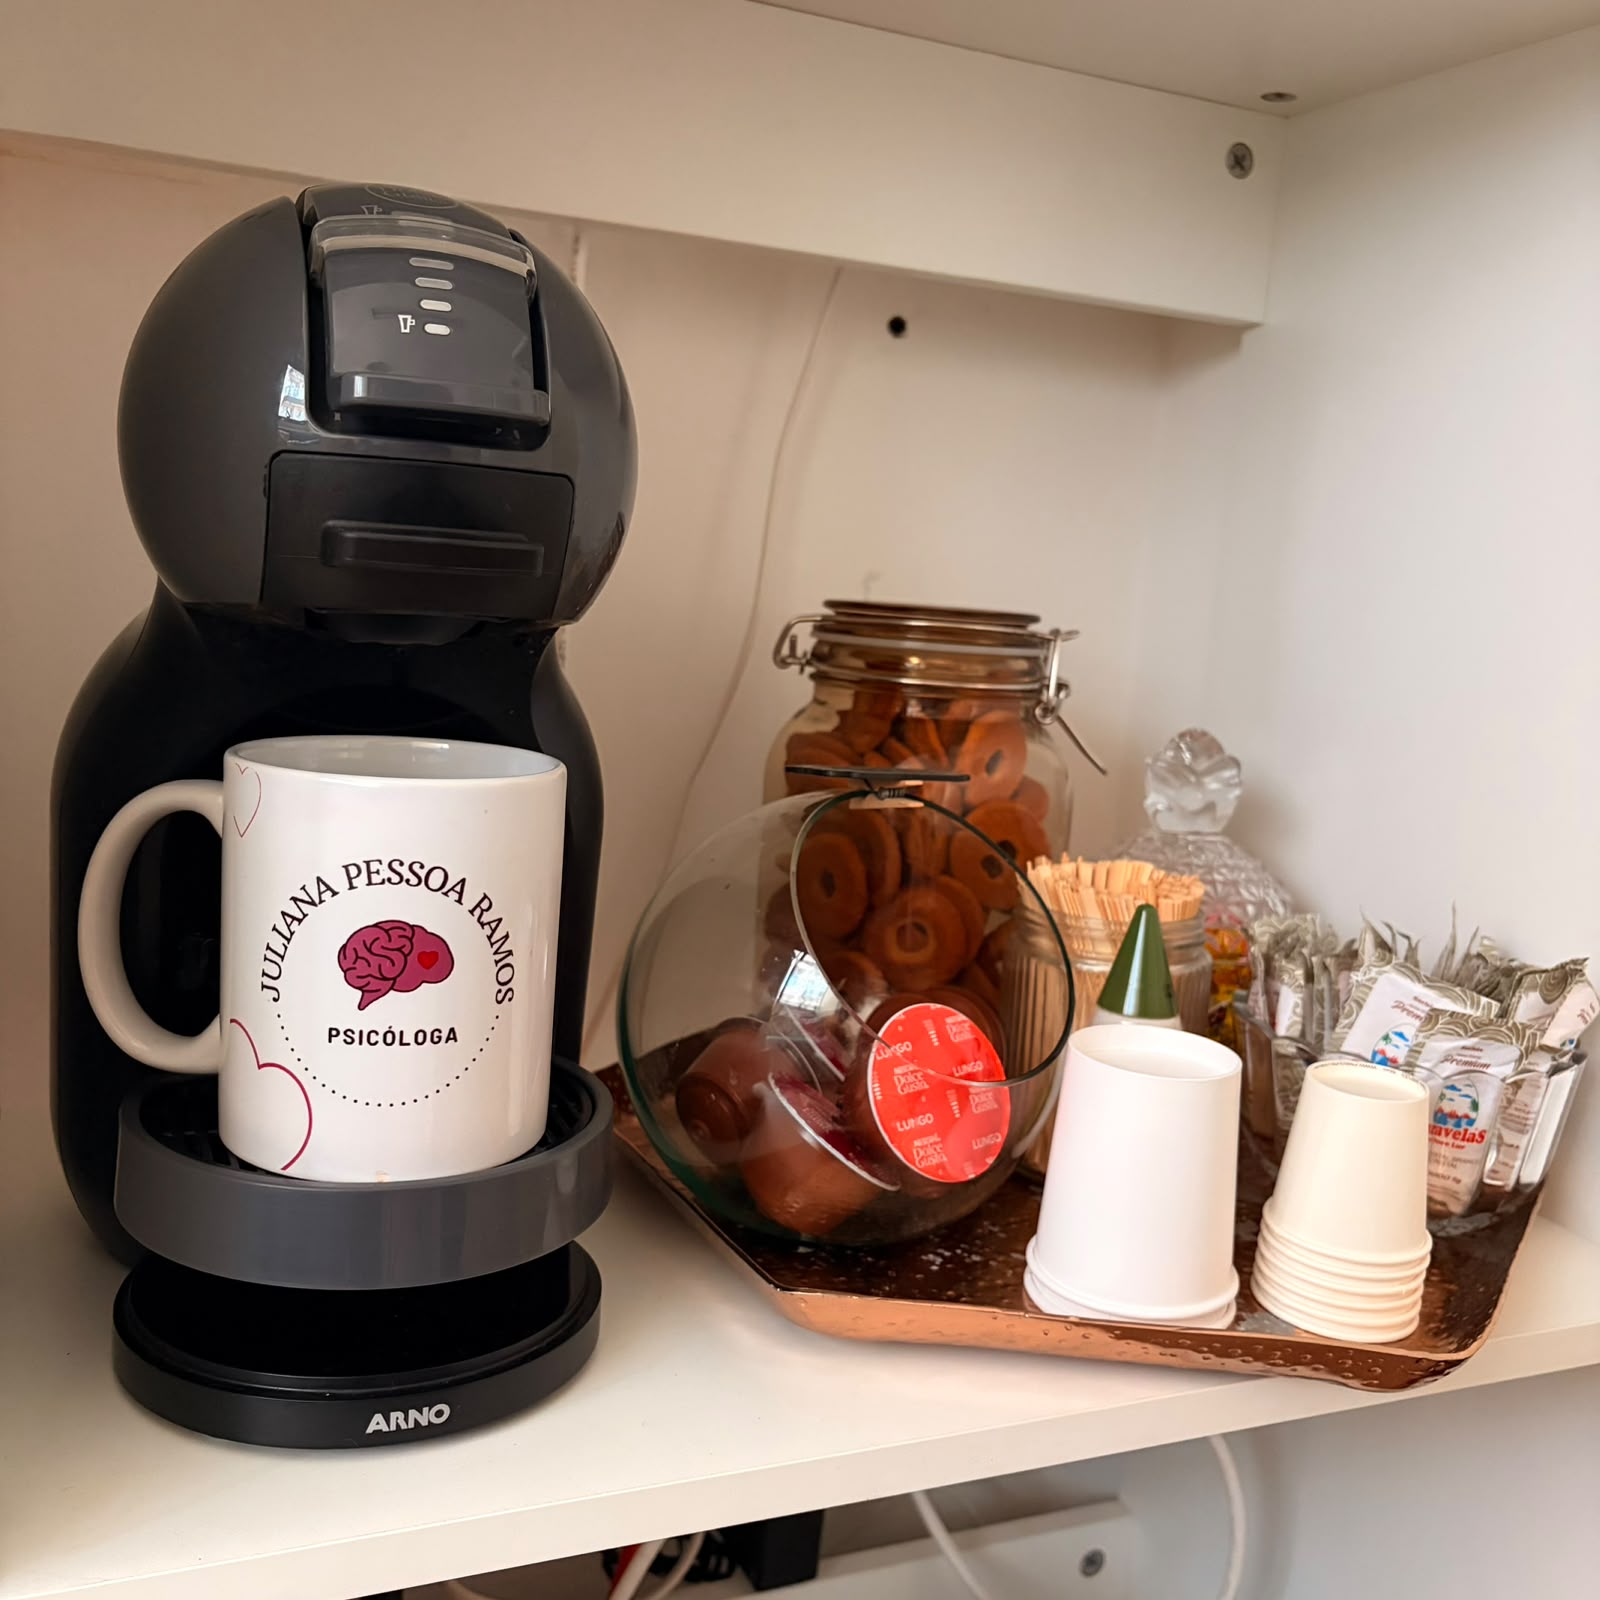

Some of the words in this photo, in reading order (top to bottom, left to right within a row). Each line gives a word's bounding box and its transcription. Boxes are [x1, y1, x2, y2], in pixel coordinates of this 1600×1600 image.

[261, 876, 340, 1003] JULIANA
[342, 859, 467, 906] PESSOA
[468, 892, 515, 1005] RAMOS
[328, 1025, 458, 1047] PSICÓLOGA
[365, 1403, 451, 1434] ARNO
